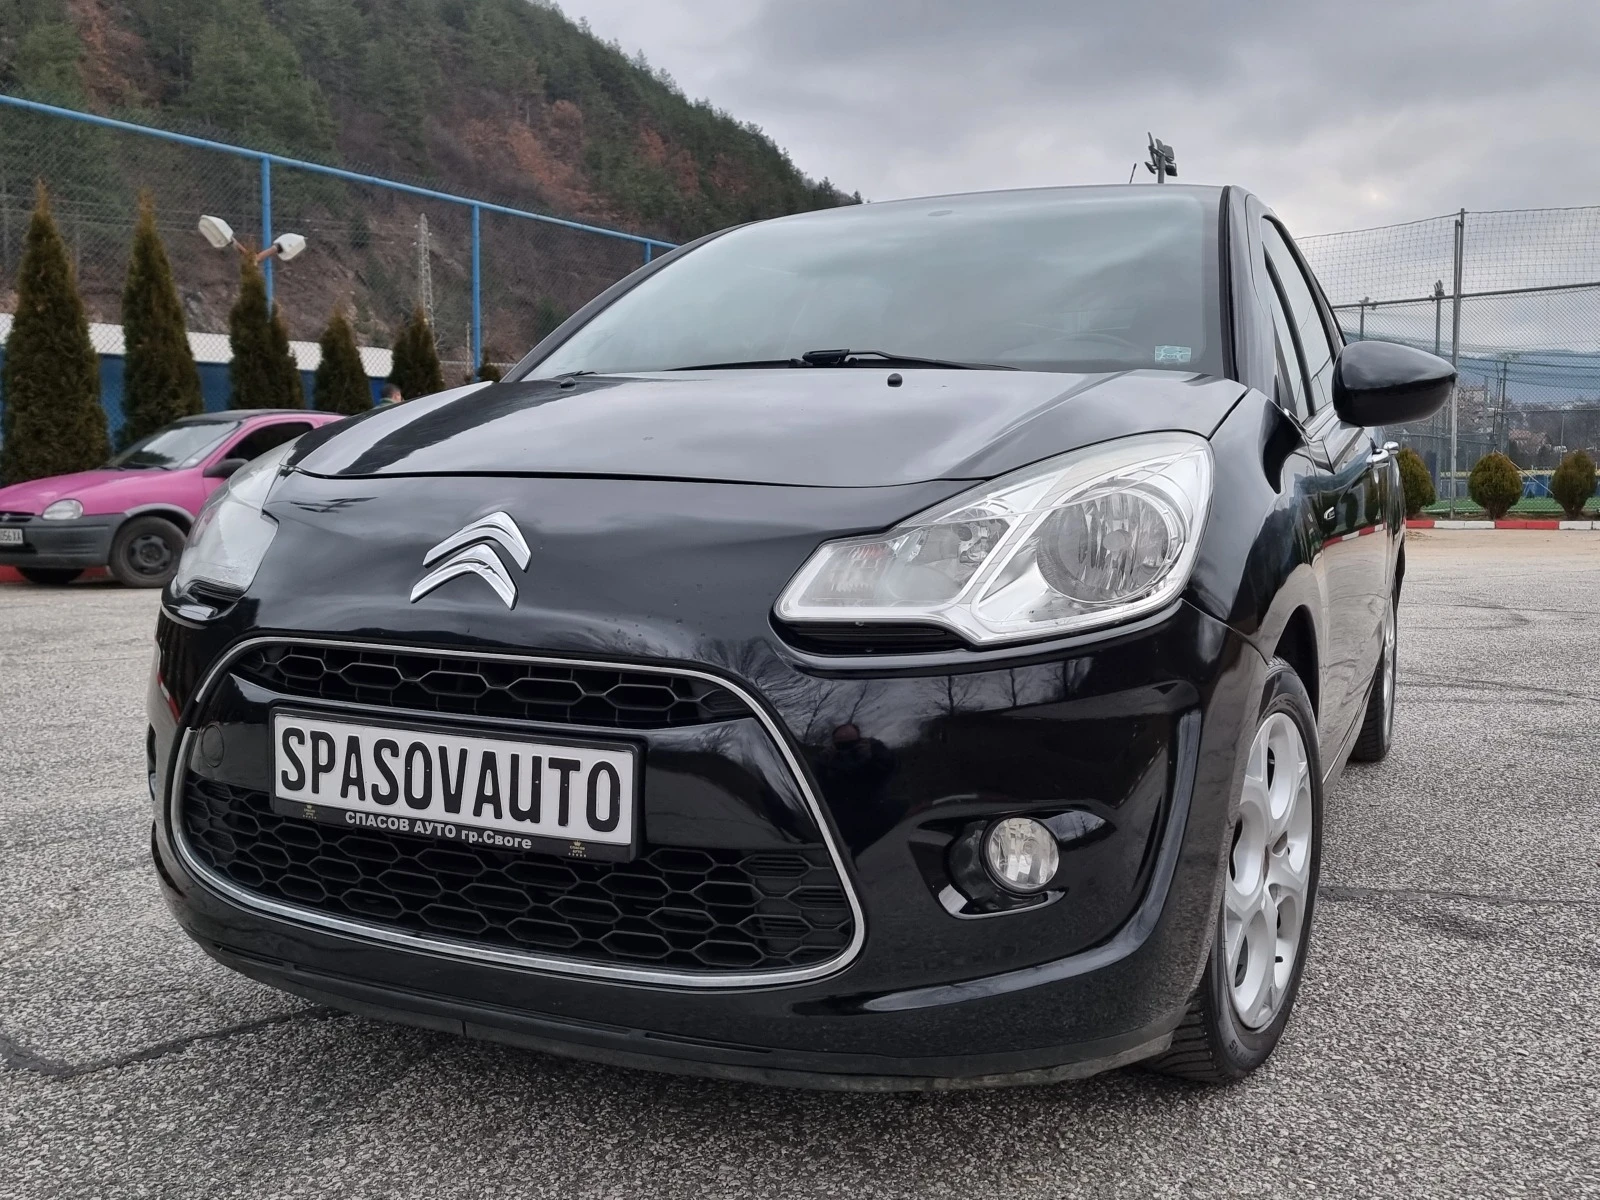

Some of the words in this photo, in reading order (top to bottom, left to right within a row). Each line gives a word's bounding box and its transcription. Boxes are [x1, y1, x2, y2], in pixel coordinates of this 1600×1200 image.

[281, 727, 621, 832] SPASOVAUTO
[345, 811, 410, 832] СПАСОВ
[413, 820, 457, 838] АУТО
[461, 829, 533, 850] гр.Своге
